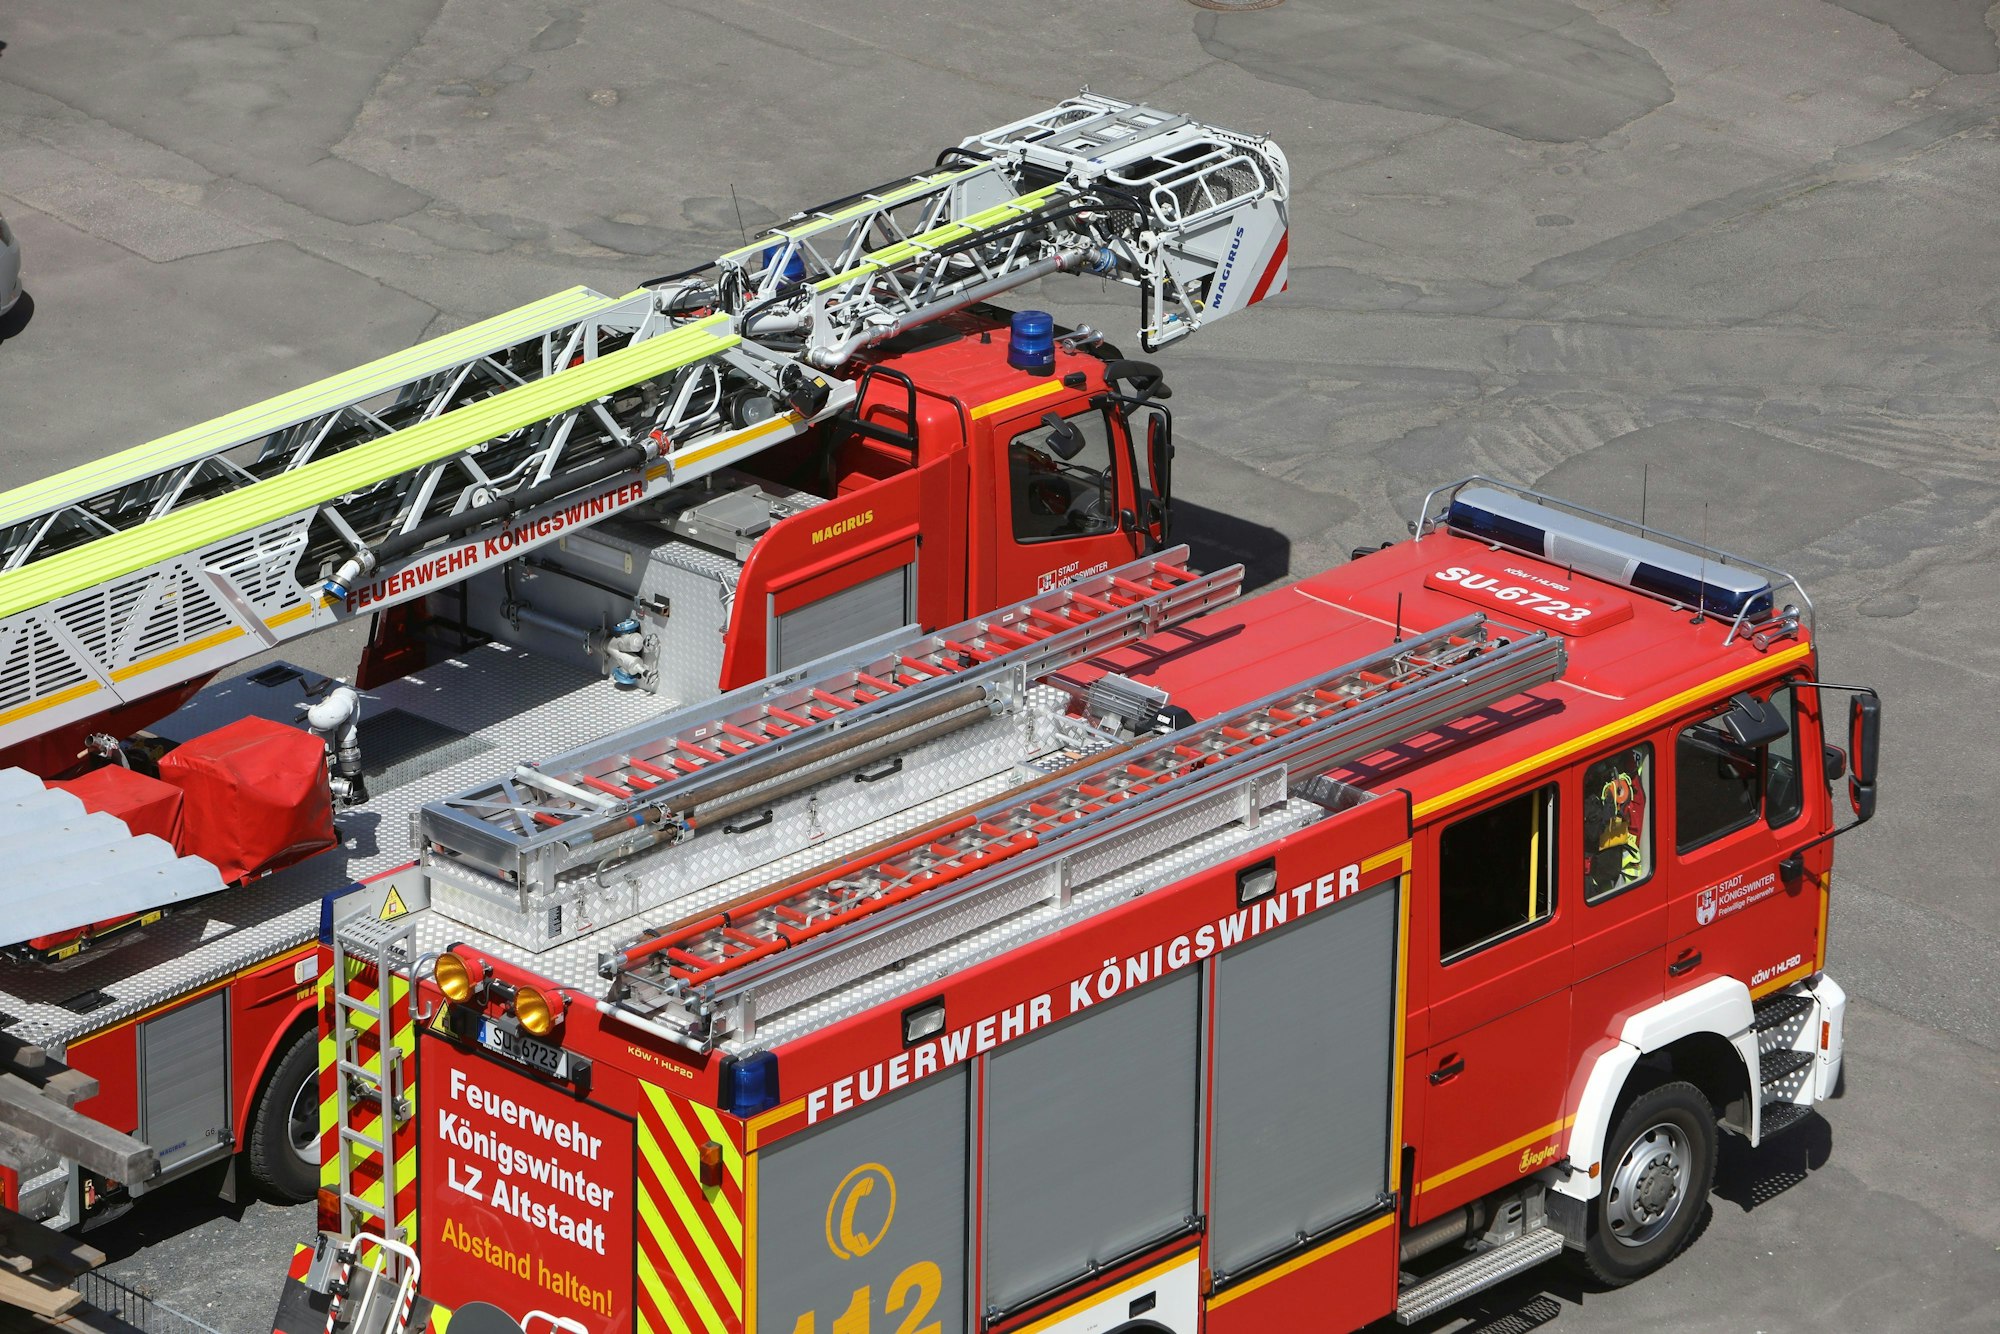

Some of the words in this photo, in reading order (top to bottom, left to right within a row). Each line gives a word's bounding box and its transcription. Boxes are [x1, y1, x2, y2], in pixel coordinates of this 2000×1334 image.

[1212, 227, 1244, 309] MAGIRUS
[346, 545, 478, 613] FEUERWEHR
[484, 480, 644, 558] KÖNIGSWINTER
[812, 510, 874, 544] MAGIRUS
[1058, 561, 1079, 576] STADT
[1434, 567, 1592, 622] SU-6723
[1719, 875, 1743, 892] STADT
[1719, 873, 1775, 905] KÖNIGSWINTER
[1746, 886, 1775, 904] Feuerwehr
[806, 992, 1052, 1125] FEUERWEHR
[1069, 863, 1361, 1013] KÖNIGSWINTER
[1752, 969, 1769, 986] KÖW
[1770, 964, 1776, 976] 1
[1777, 954, 1800, 973] HLF20
[493, 1027, 512, 1052] SU
[521, 1040, 559, 1070] 6723
[627, 1046, 652, 1062] KÖW
[653, 1057, 659, 1065] 1
[661, 1060, 694, 1080] HLF20
[450, 1068, 602, 1161] Feuerwehr
[438, 1109, 614, 1212] Königswinter
[1519, 1143, 1559, 1173] Ziegler
[448, 1157, 483, 1201] LZ
[491, 1178, 605, 1255] Altstadt
[441, 1218, 531, 1281] Abstand
[538, 1258, 613, 1318] halten!
[793, 1260, 942, 1334] 12
